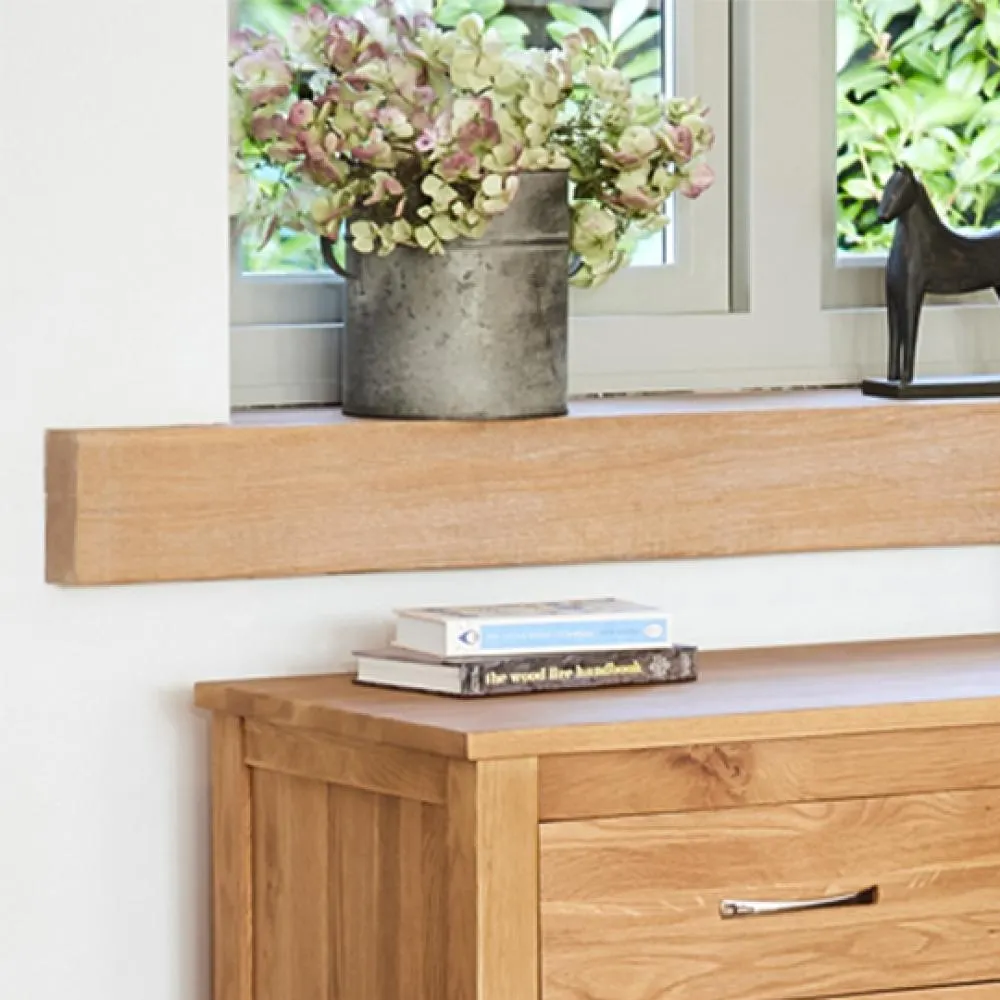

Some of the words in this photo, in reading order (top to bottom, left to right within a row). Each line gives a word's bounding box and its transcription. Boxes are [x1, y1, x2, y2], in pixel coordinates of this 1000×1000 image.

[485, 671, 507, 686] the
[510, 667, 546, 684] wood
[550, 665, 573, 681] fire
[576, 660, 642, 677] handbook
